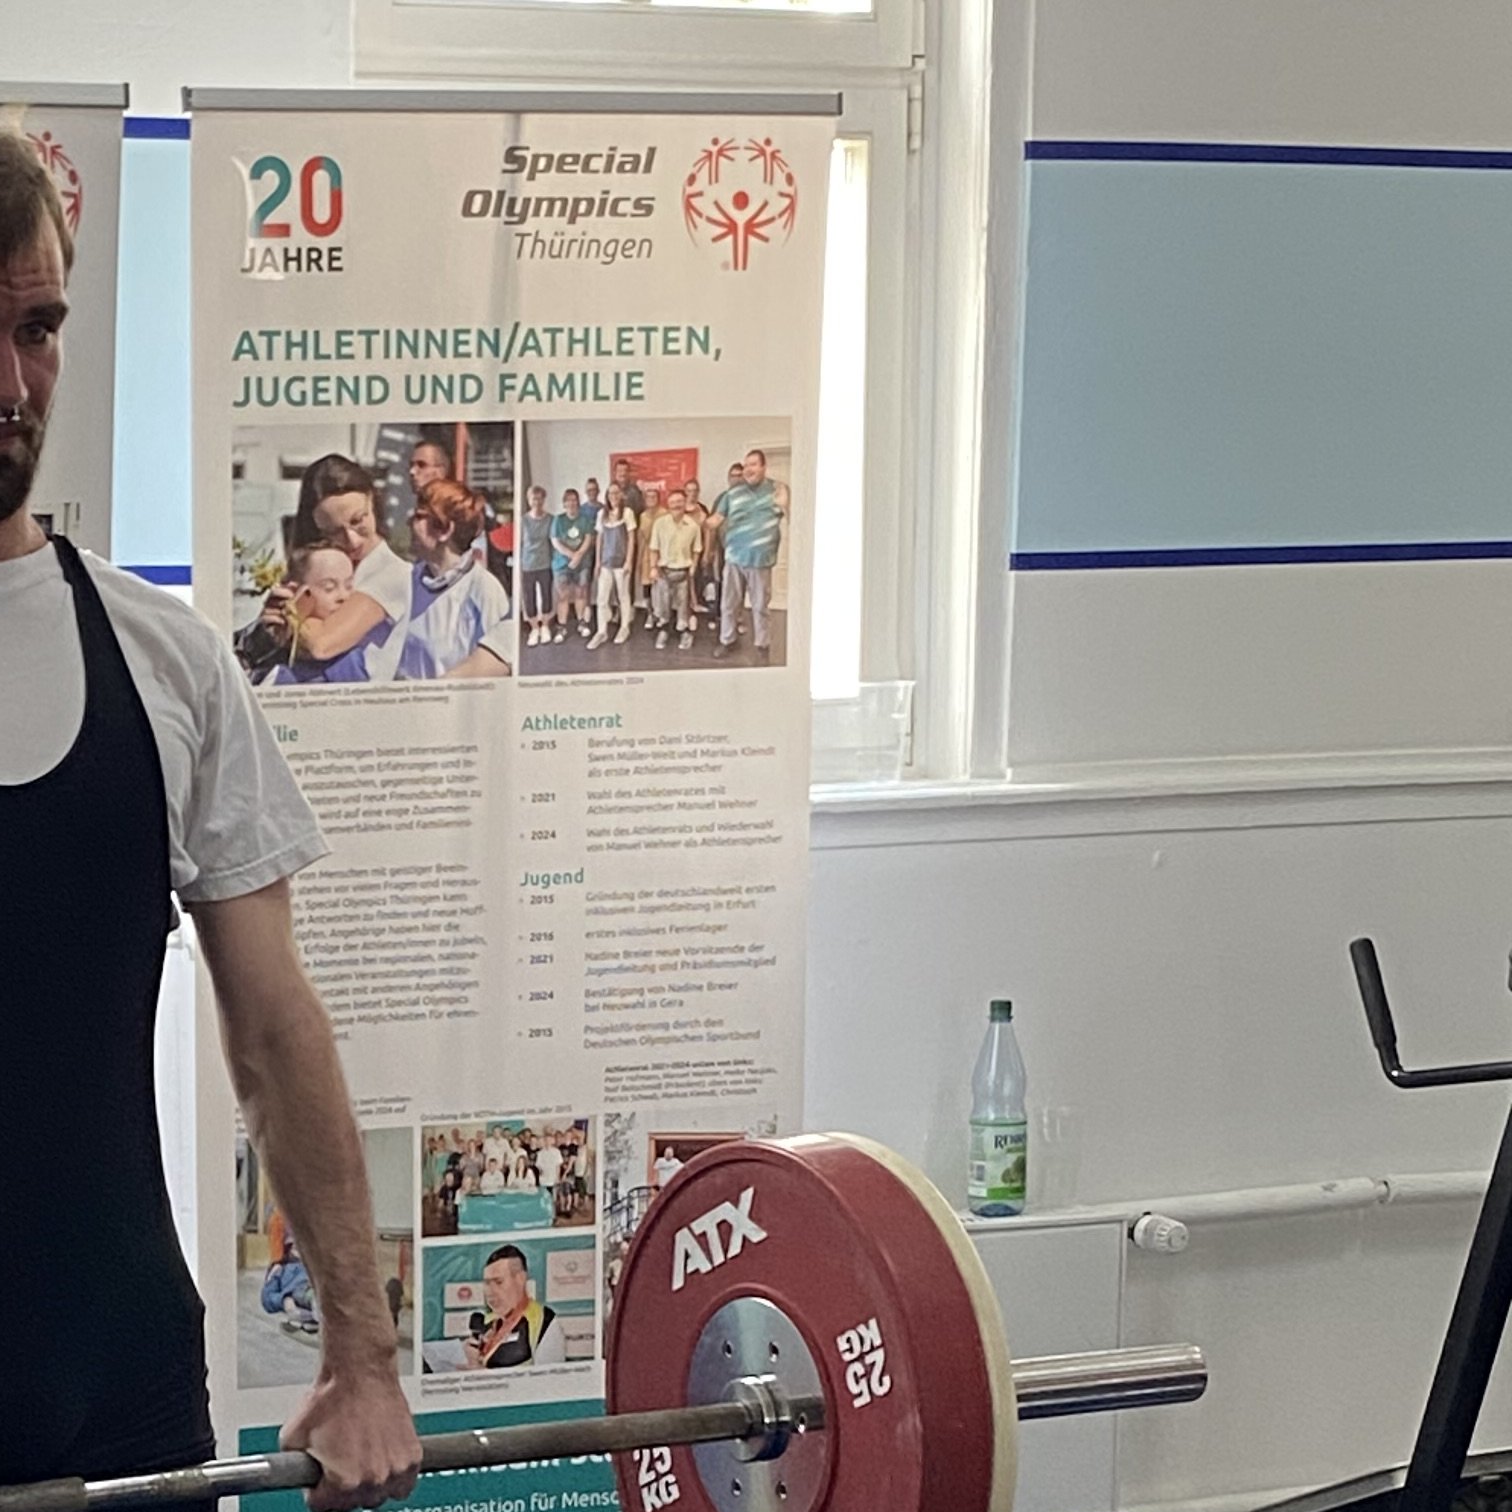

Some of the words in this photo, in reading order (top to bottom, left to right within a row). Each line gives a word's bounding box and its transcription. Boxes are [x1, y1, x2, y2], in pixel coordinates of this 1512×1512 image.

[501, 145, 657, 180] Special
[249, 155, 344, 239] 20
[461, 188, 656, 224] Olympics
[240, 247, 344, 275] JAHRE
[513, 231, 653, 264] Thüringen
[232, 321, 723, 363] ATHLETINNEN/ATHLETEN,
[232, 375, 390, 408] JUGEND
[404, 373, 484, 403] UND
[498, 371, 646, 402] FAMILIE
[521, 713, 623, 732] Athletenrat
[531, 740, 557, 750] 2015
[531, 830, 556, 840] 2024
[519, 867, 584, 889] Jugend
[671, 1187, 767, 1291] ATX
[835, 1318, 882, 1362] KG
[844, 1347, 892, 1409] 25
[530, 1492, 557, 1511] für
[562, 1490, 620, 1508] Mensc
[641, 1473, 680, 1512] KG
